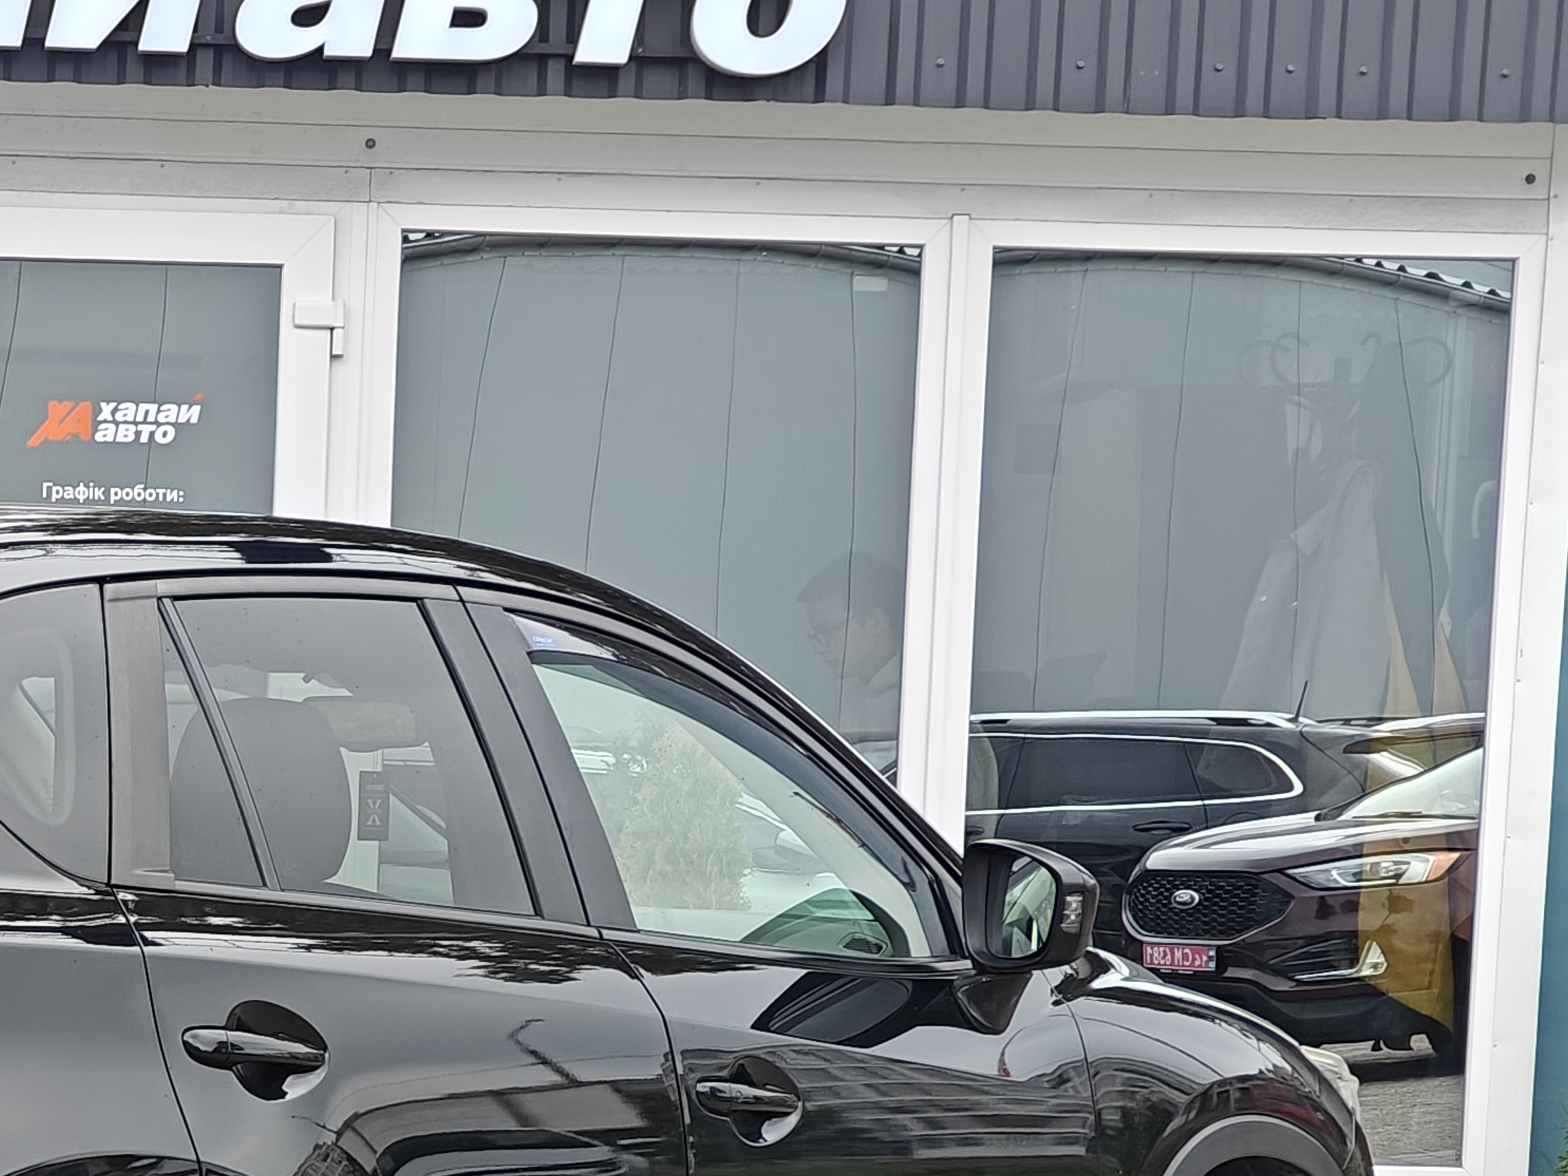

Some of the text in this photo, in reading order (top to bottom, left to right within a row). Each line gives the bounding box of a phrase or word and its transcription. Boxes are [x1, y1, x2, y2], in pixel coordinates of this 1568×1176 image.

[94, 424, 176, 444] авто
[42, 482, 184, 504] Графік роботи:
